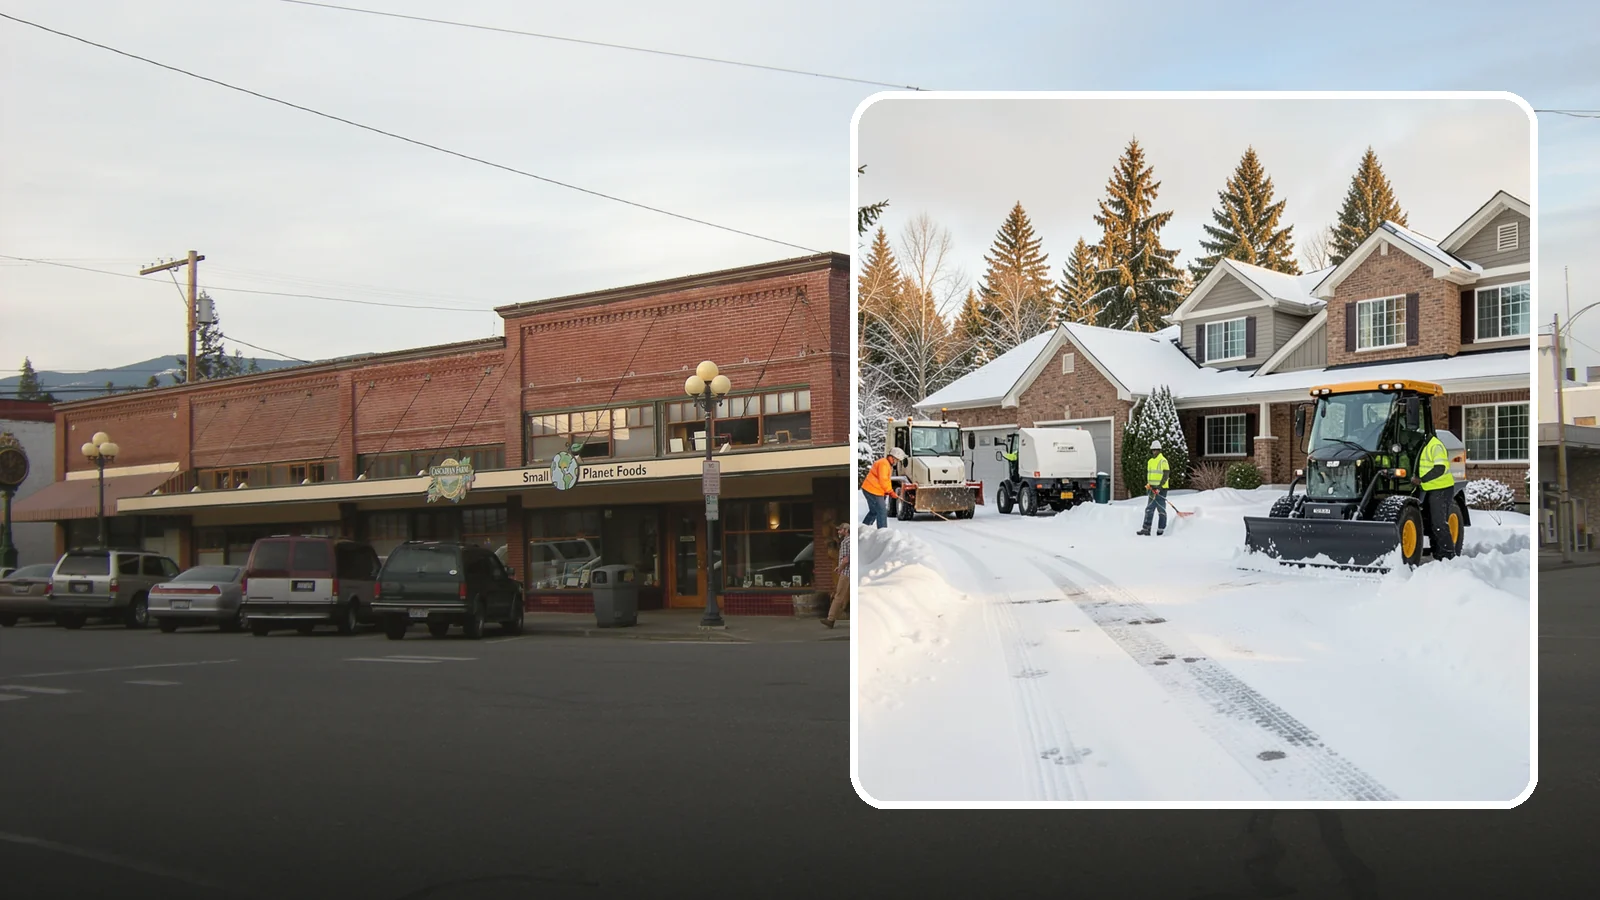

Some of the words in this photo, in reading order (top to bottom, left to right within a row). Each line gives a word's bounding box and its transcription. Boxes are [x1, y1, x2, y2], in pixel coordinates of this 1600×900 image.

[431, 466, 456, 476] CASCADIAN
[456, 465, 469, 474] FARM
[523, 471, 549, 483] Small
[583, 467, 614, 479] Planet
[616, 464, 647, 477] Foods
